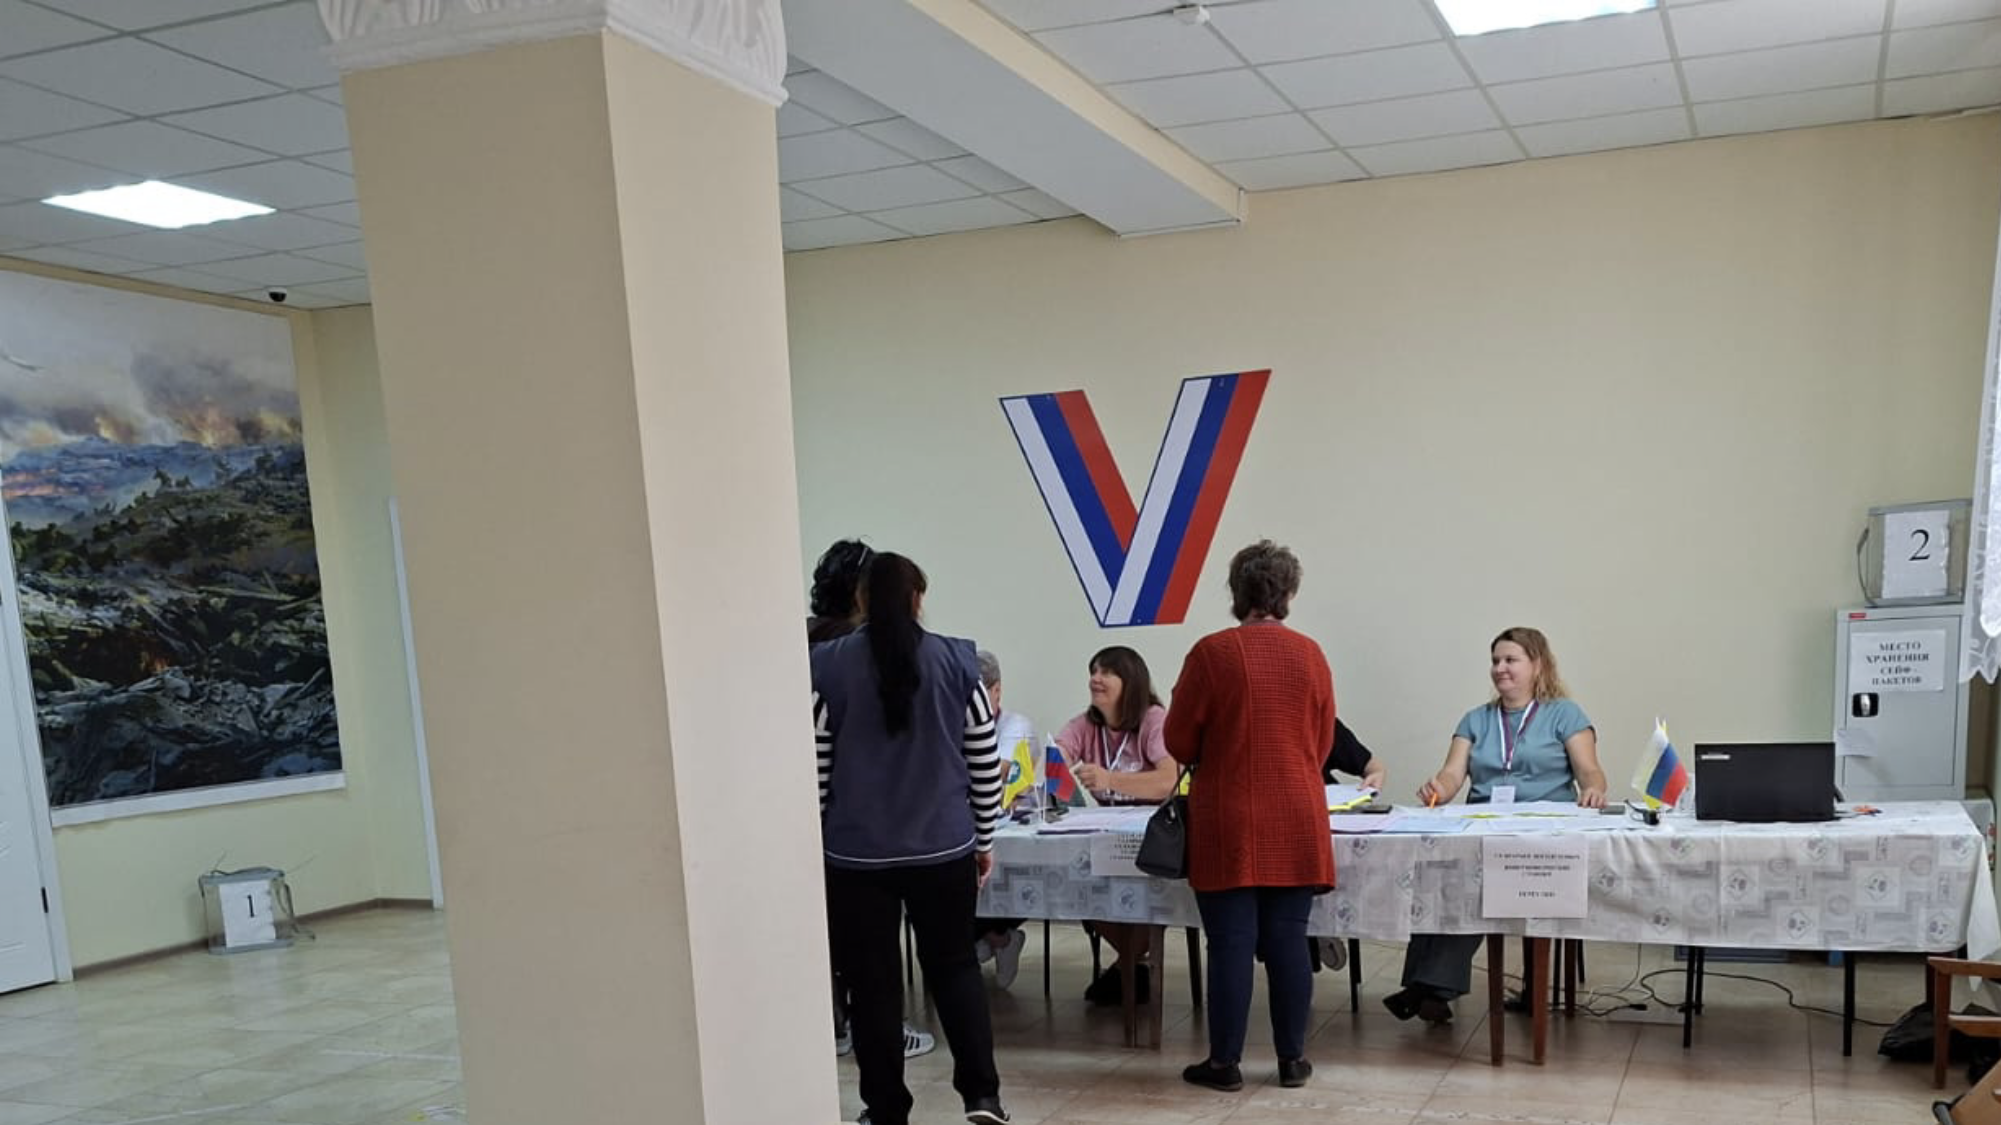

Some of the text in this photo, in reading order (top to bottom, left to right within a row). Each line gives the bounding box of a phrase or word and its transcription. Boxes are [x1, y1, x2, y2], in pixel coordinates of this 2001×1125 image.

[999, 368, 1272, 628] V
[1909, 529, 1930, 561] 2
[1879, 641, 1921, 651] МЕСТО
[1866, 653, 1930, 664] ХРАНЕНИЯ
[1872, 676, 1922, 686] ПАКЕТОВ
[246, 894, 255, 918] 1
